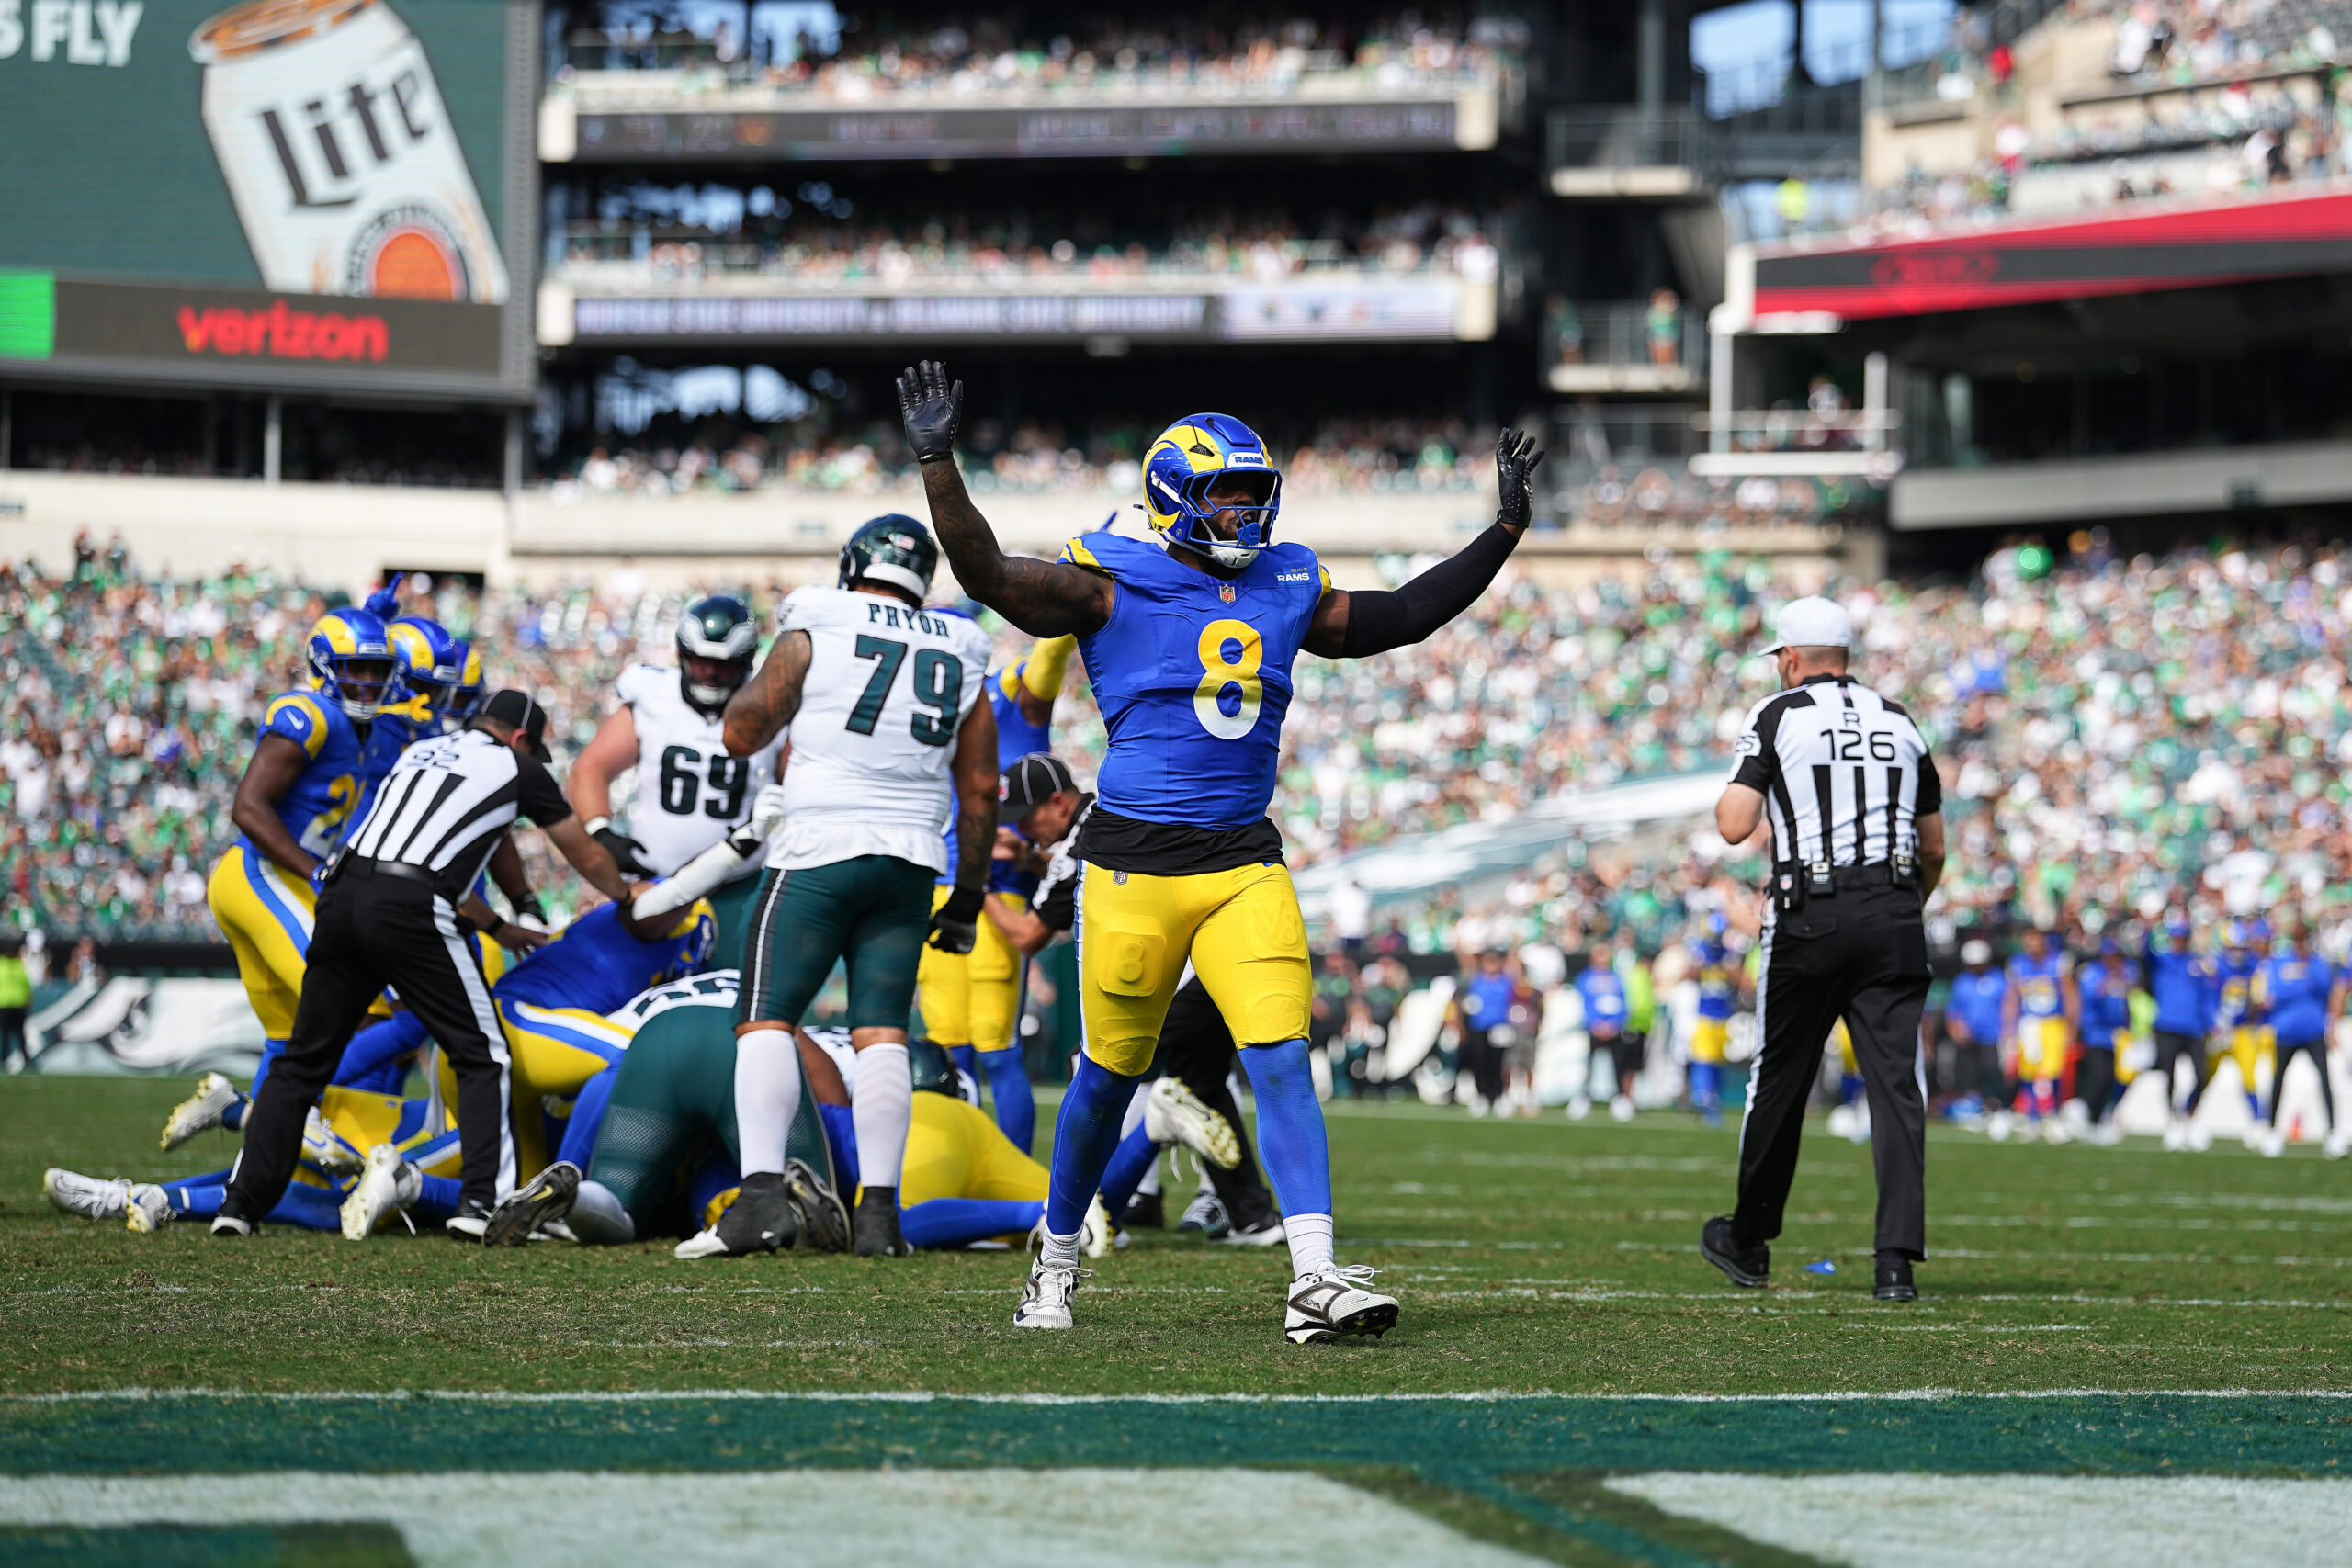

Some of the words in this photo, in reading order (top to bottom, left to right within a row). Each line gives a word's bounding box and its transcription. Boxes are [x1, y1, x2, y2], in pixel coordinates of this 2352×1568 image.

[31, 0, 144, 68] FLY
[262, 70, 429, 207] Lite
[178, 299, 389, 362] verizon
[1235, 456, 1264, 465] RAMS
[1276, 572, 1310, 582] RAMS
[845, 634, 963, 747] 79
[1193, 618, 1263, 740] 8
[1820, 729, 1895, 761] 126
[1842, 712, 1861, 729] R
[662, 745, 750, 820] 69
[1118, 942, 1145, 984] 8
